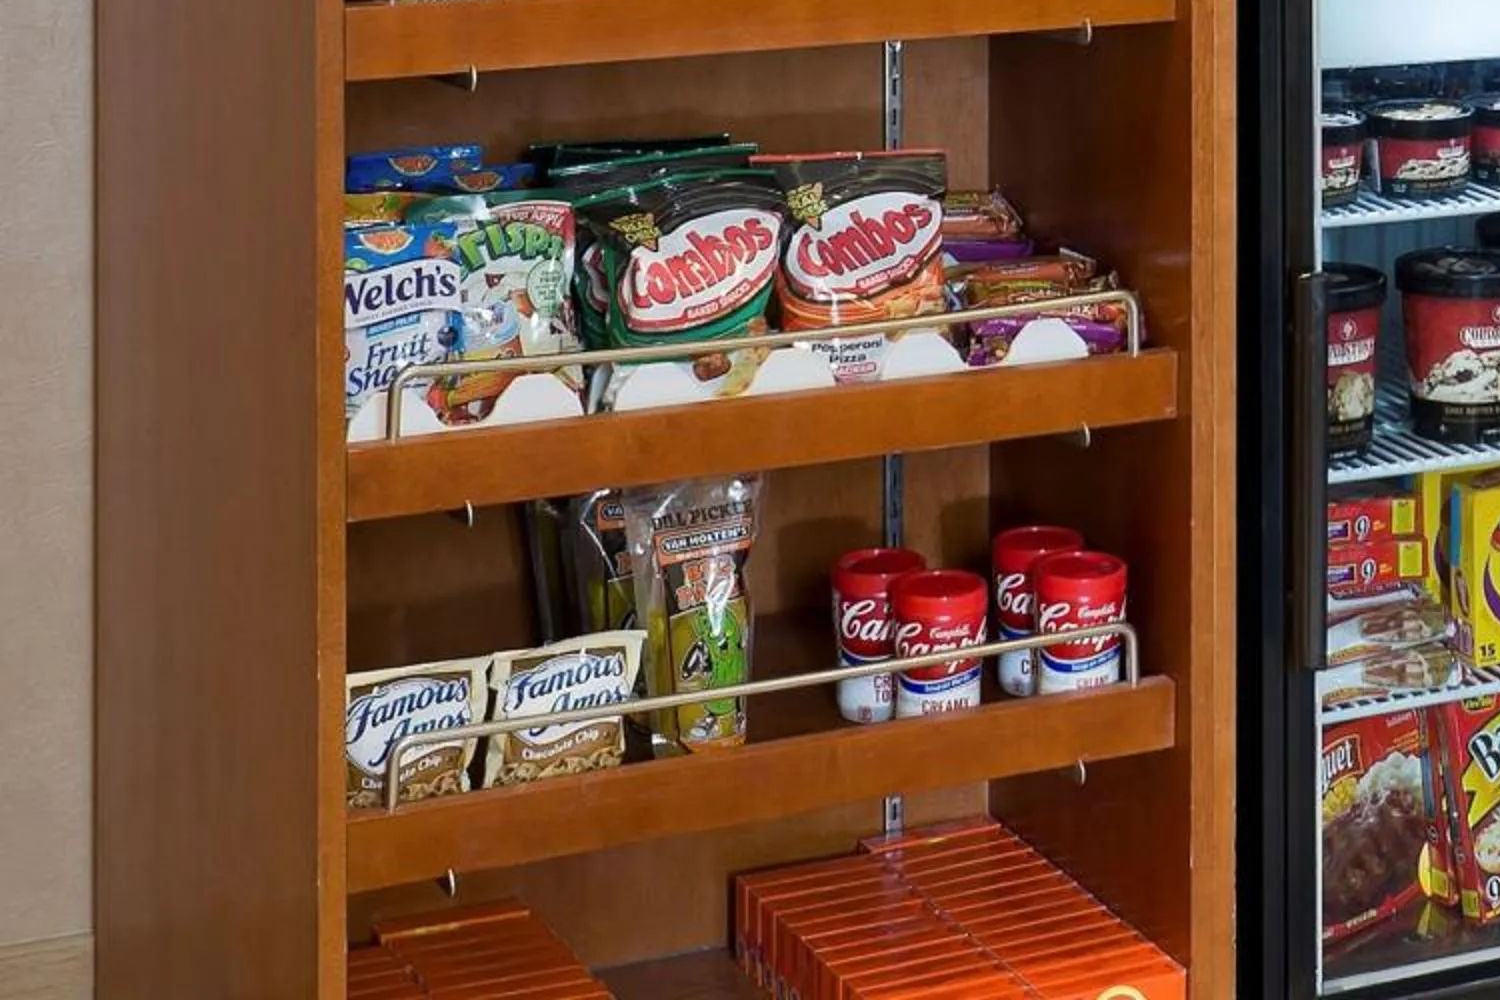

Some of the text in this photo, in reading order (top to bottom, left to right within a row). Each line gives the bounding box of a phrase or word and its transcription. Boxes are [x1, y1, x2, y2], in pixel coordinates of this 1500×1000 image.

[798, 204, 932, 276] Combos
[632, 217, 773, 308] Combos
[366, 332, 431, 369] Fruit
[829, 353, 867, 364] Pizza
[1354, 514, 1370, 542] 9
[1361, 558, 1377, 585] 9
[1479, 643, 1497, 657] 15
[504, 652, 624, 711] Famous
[345, 678, 471, 744] Famous
[921, 698, 971, 715] CREAMY
[521, 729, 600, 761] Chocolate Chip
